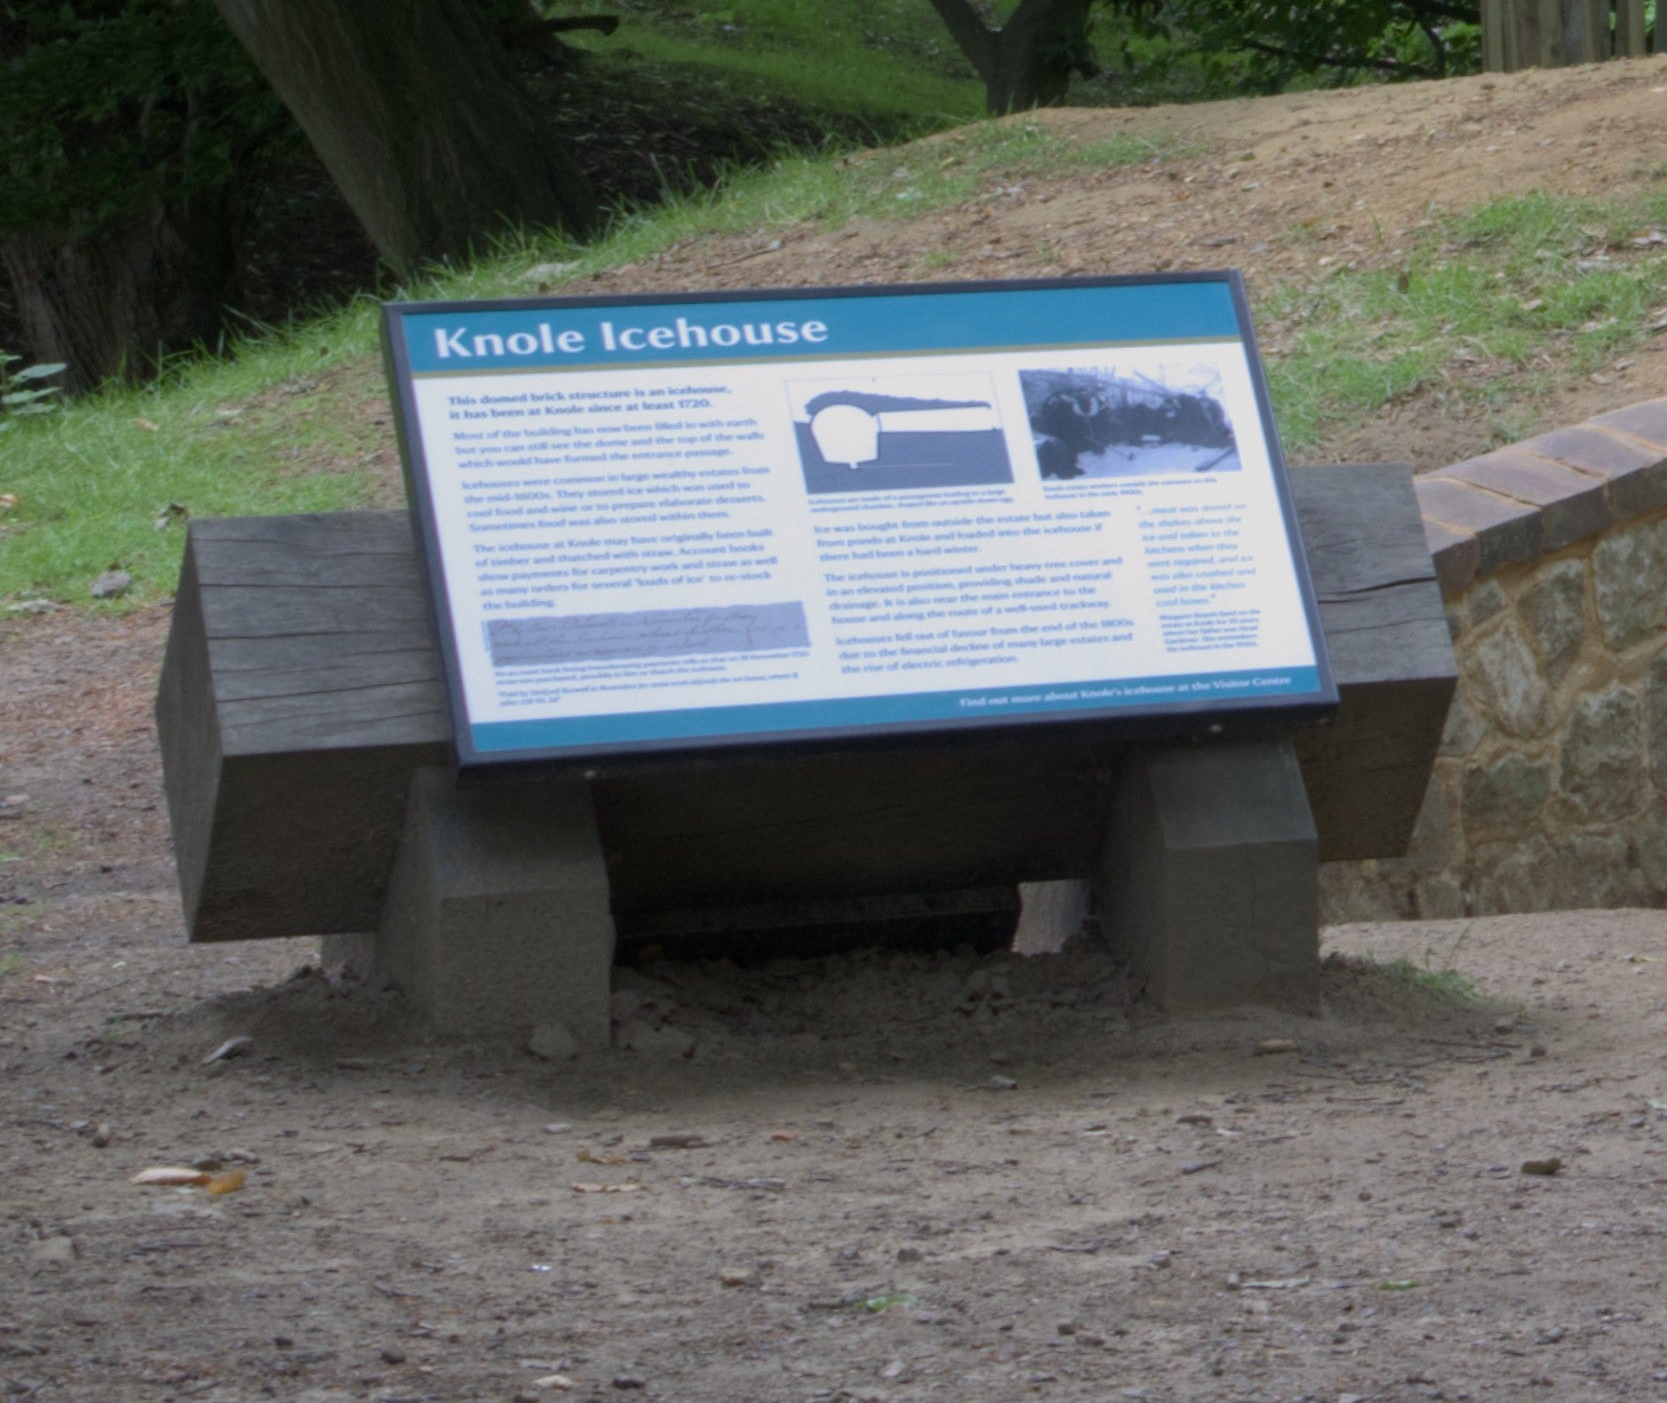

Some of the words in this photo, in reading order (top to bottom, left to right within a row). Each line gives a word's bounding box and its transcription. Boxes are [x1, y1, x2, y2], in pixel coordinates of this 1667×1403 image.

[435, 323, 583, 358] Knole
[601, 318, 826, 350] Icehouse
[448, 396, 478, 406] This
[479, 393, 528, 405] domed
[529, 391, 566, 403] brick
[568, 390, 631, 401] structure
[633, 388, 647, 398] is
[648, 389, 666, 397] an
[448, 410, 461, 421] it
[463, 409, 489, 420] has
[490, 408, 525, 419] been
[527, 407, 542, 417] at
[544, 405, 585, 415] Knole
[587, 404, 623, 414] since
[625, 403, 640, 412] at
[641, 401, 675, 411] least
[959, 696, 987, 707] Find
[988, 696, 1009, 706] out
[1011, 694, 1042, 704] more
[1043, 691, 1079, 702] about
[1123, 685, 1175, 696] icehouse
[1177, 683, 1190, 693] at
[1190, 681, 1212, 691] the
[1212, 679, 1250, 689] Visitor
[1251, 677, 1291, 687] Centre
